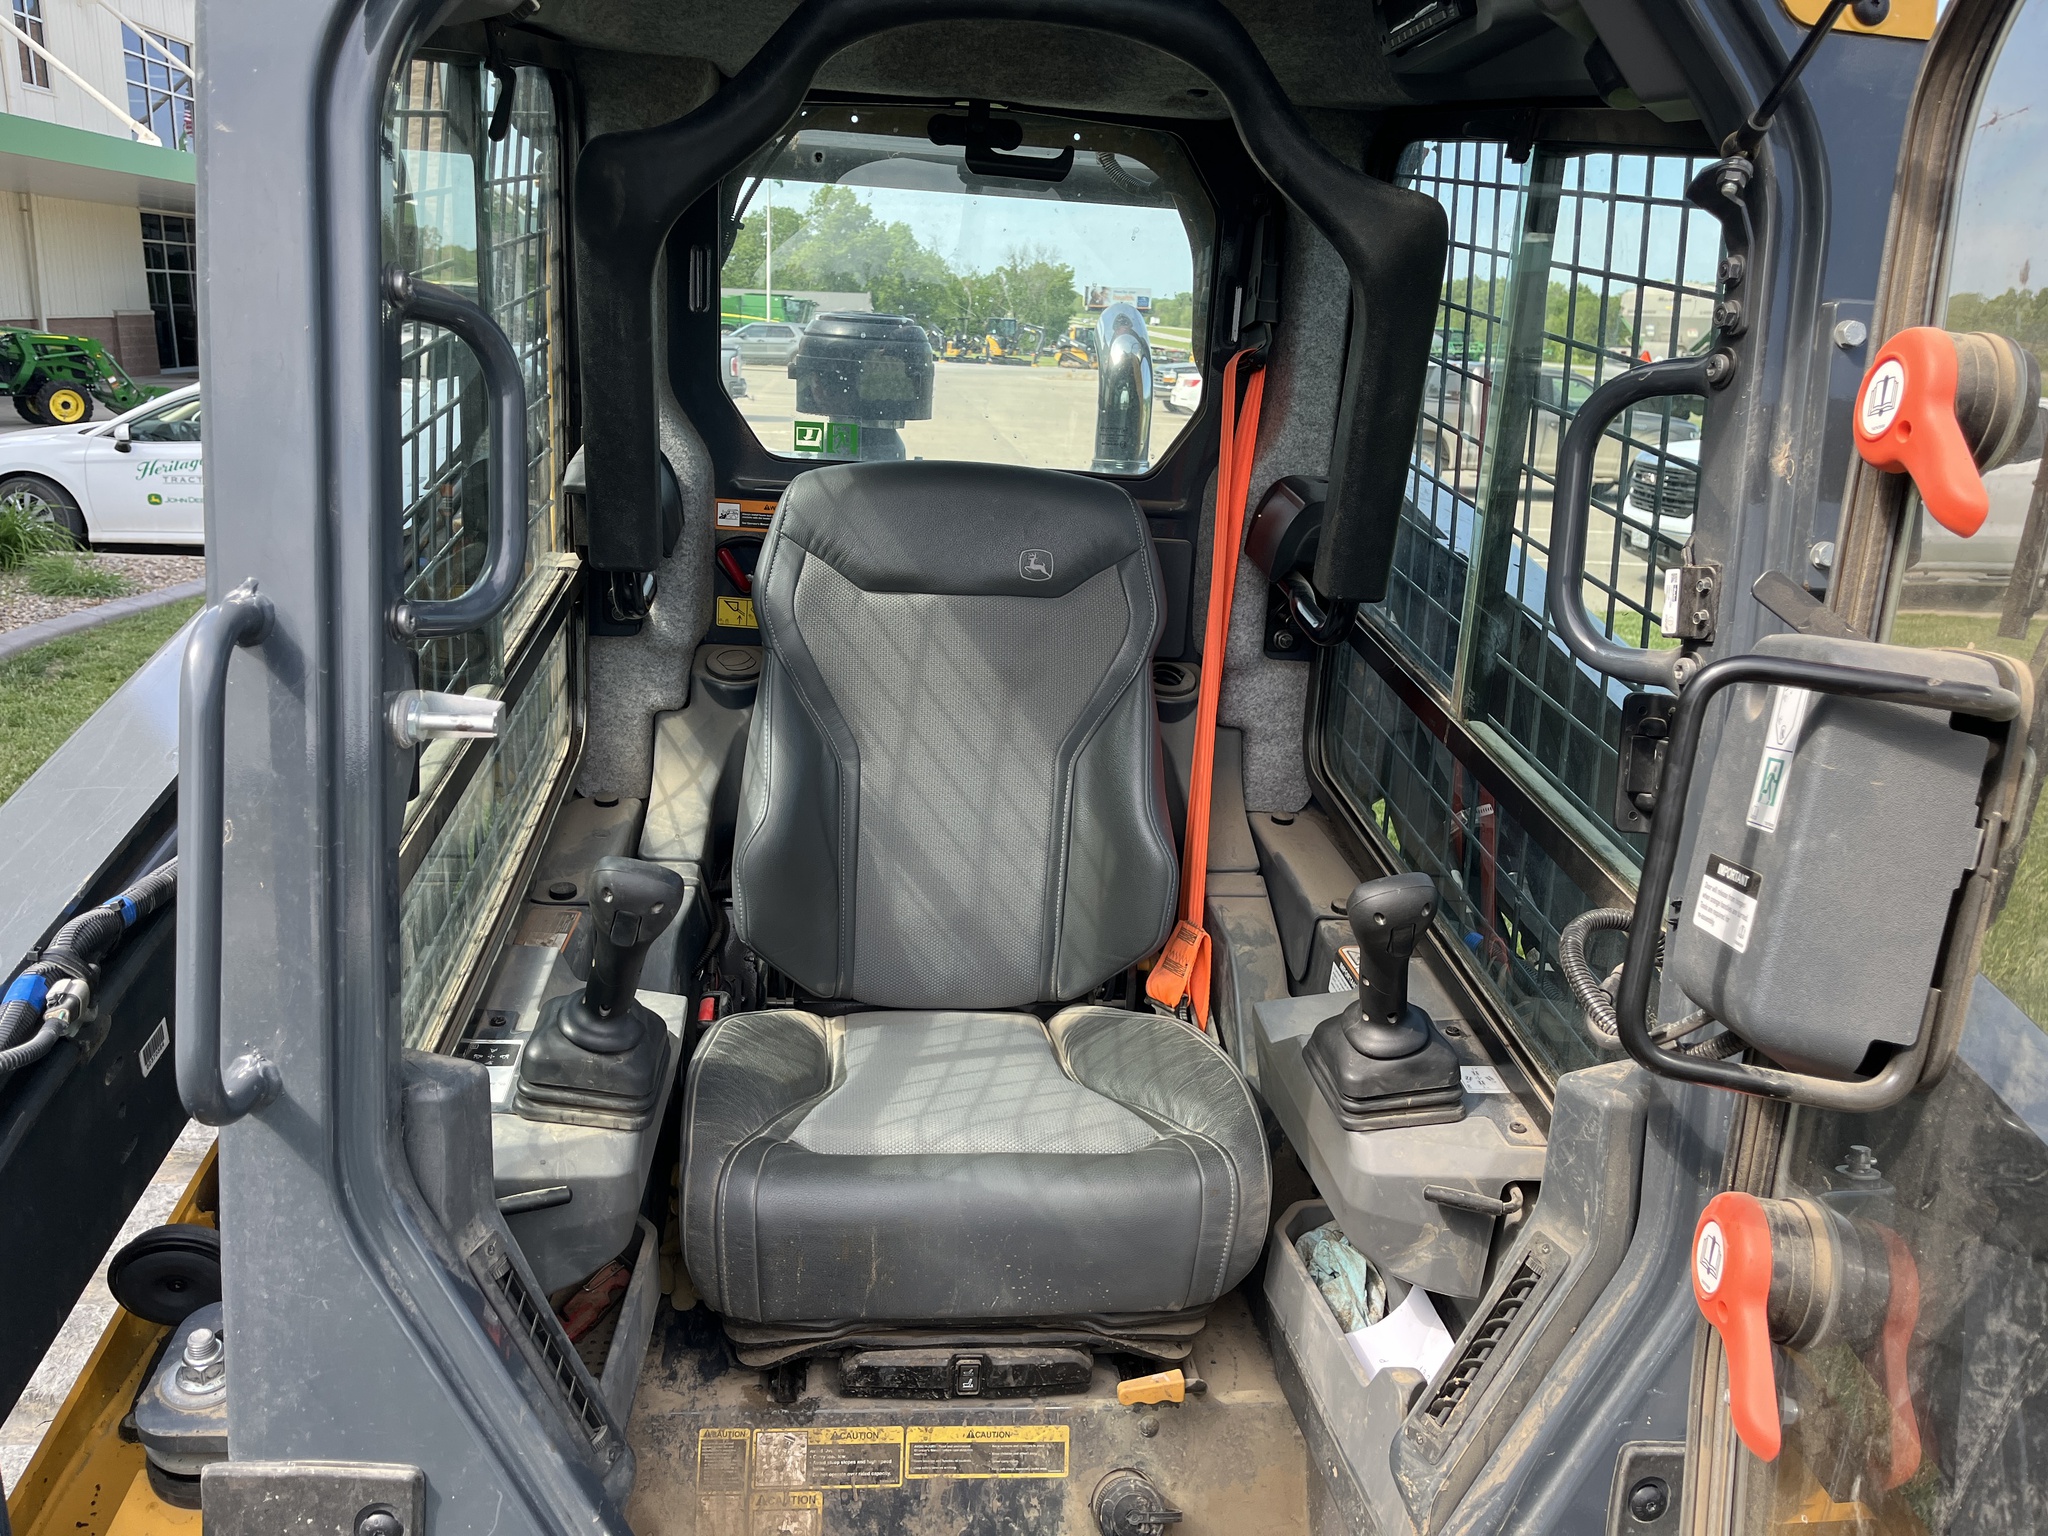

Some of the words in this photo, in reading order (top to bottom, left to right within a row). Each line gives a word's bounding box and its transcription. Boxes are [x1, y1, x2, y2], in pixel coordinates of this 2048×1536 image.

[1717, 863, 1750, 887] IMPORTANT
[840, 1431, 880, 1441] CAUTION
[975, 1431, 1011, 1439] CAUTION
